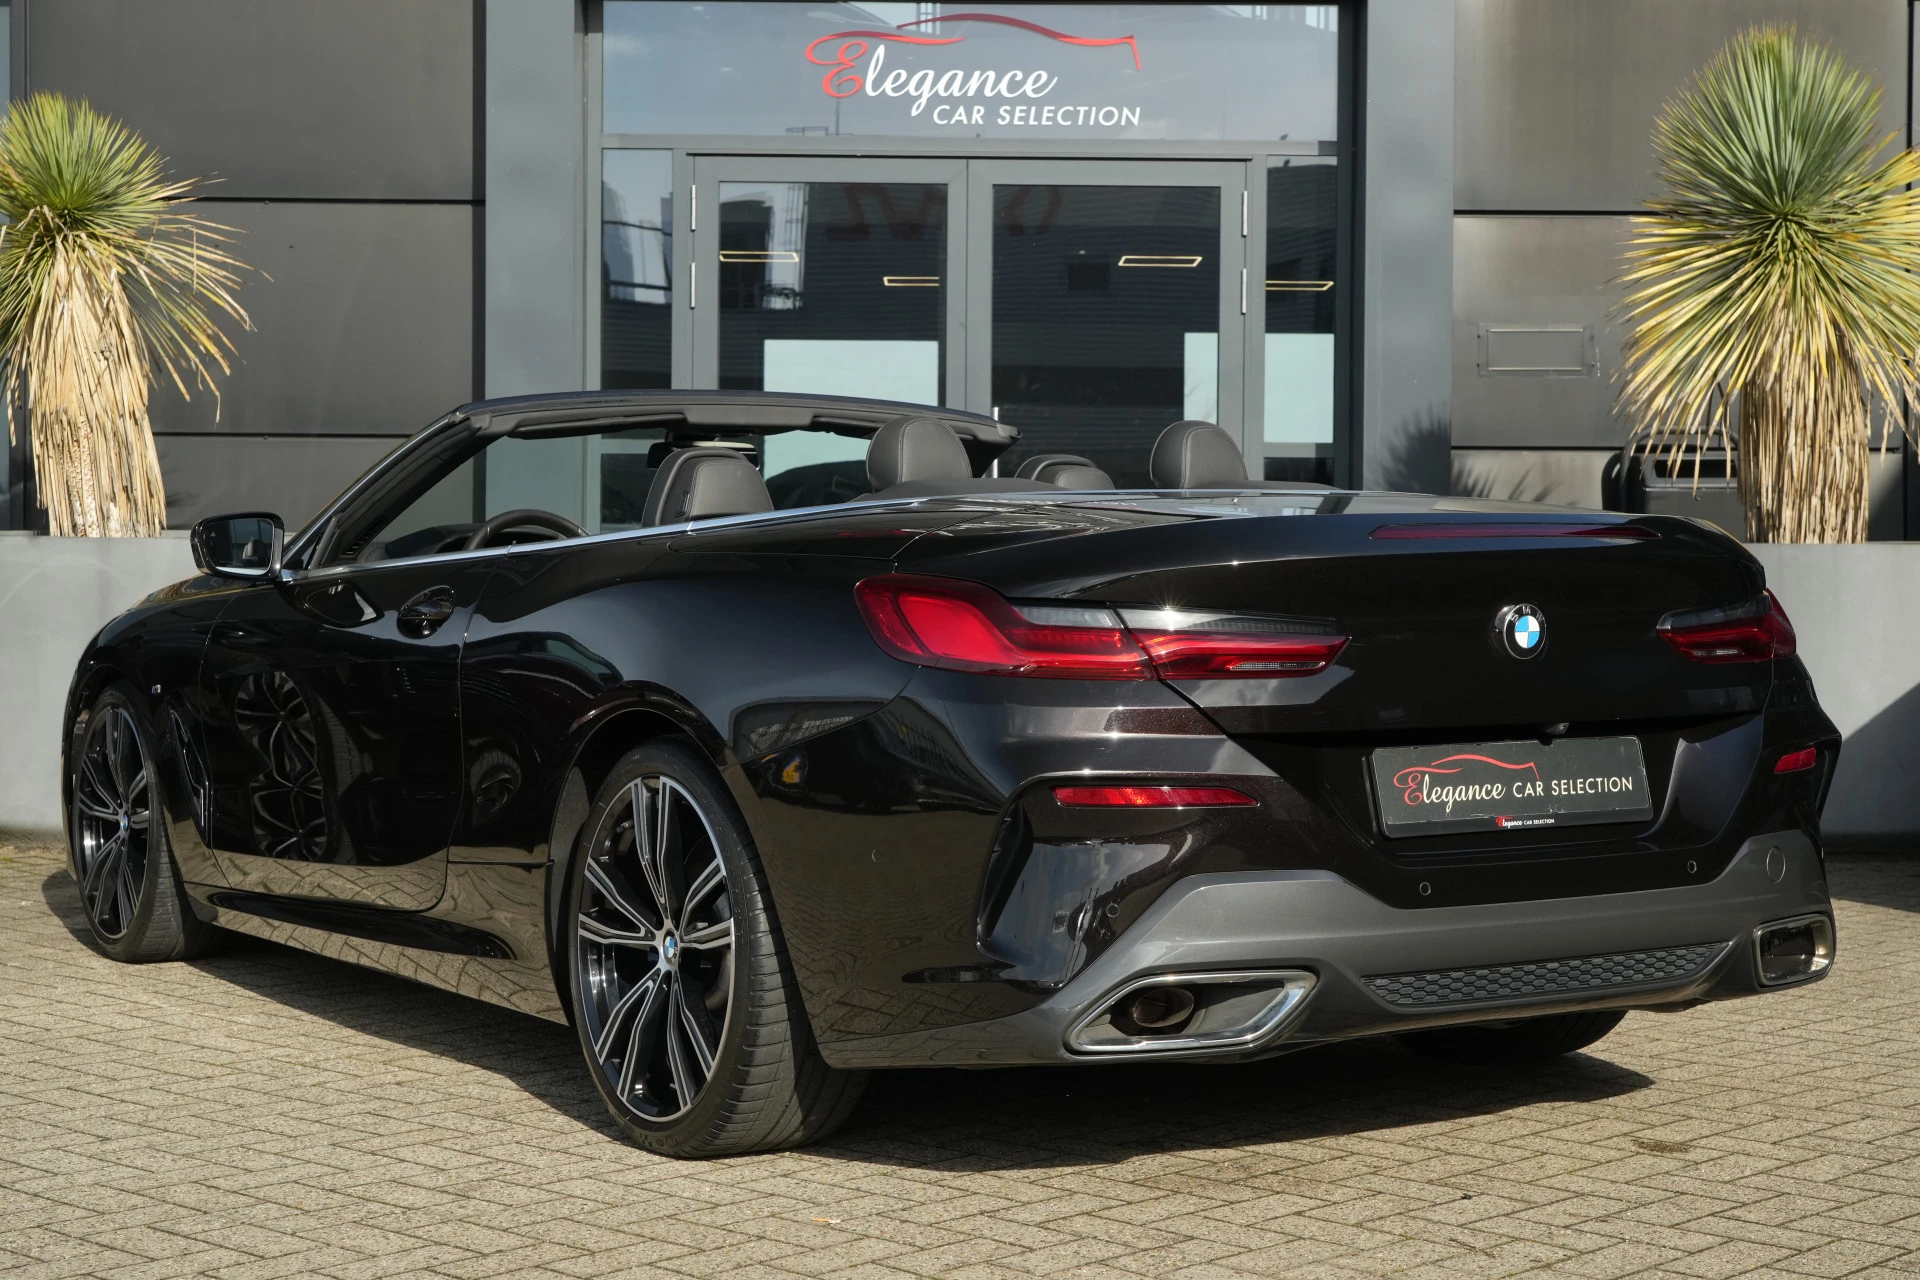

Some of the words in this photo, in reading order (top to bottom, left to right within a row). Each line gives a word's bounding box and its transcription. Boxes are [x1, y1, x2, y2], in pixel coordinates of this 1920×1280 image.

[805, 36, 1058, 117] Elegance
[932, 105, 985, 126] CAR
[996, 105, 1142, 127] SELECTION
[1394, 768, 1506, 814] Elegance
[1512, 781, 1545, 798] CAR
[1551, 776, 1633, 796] SELECTION
